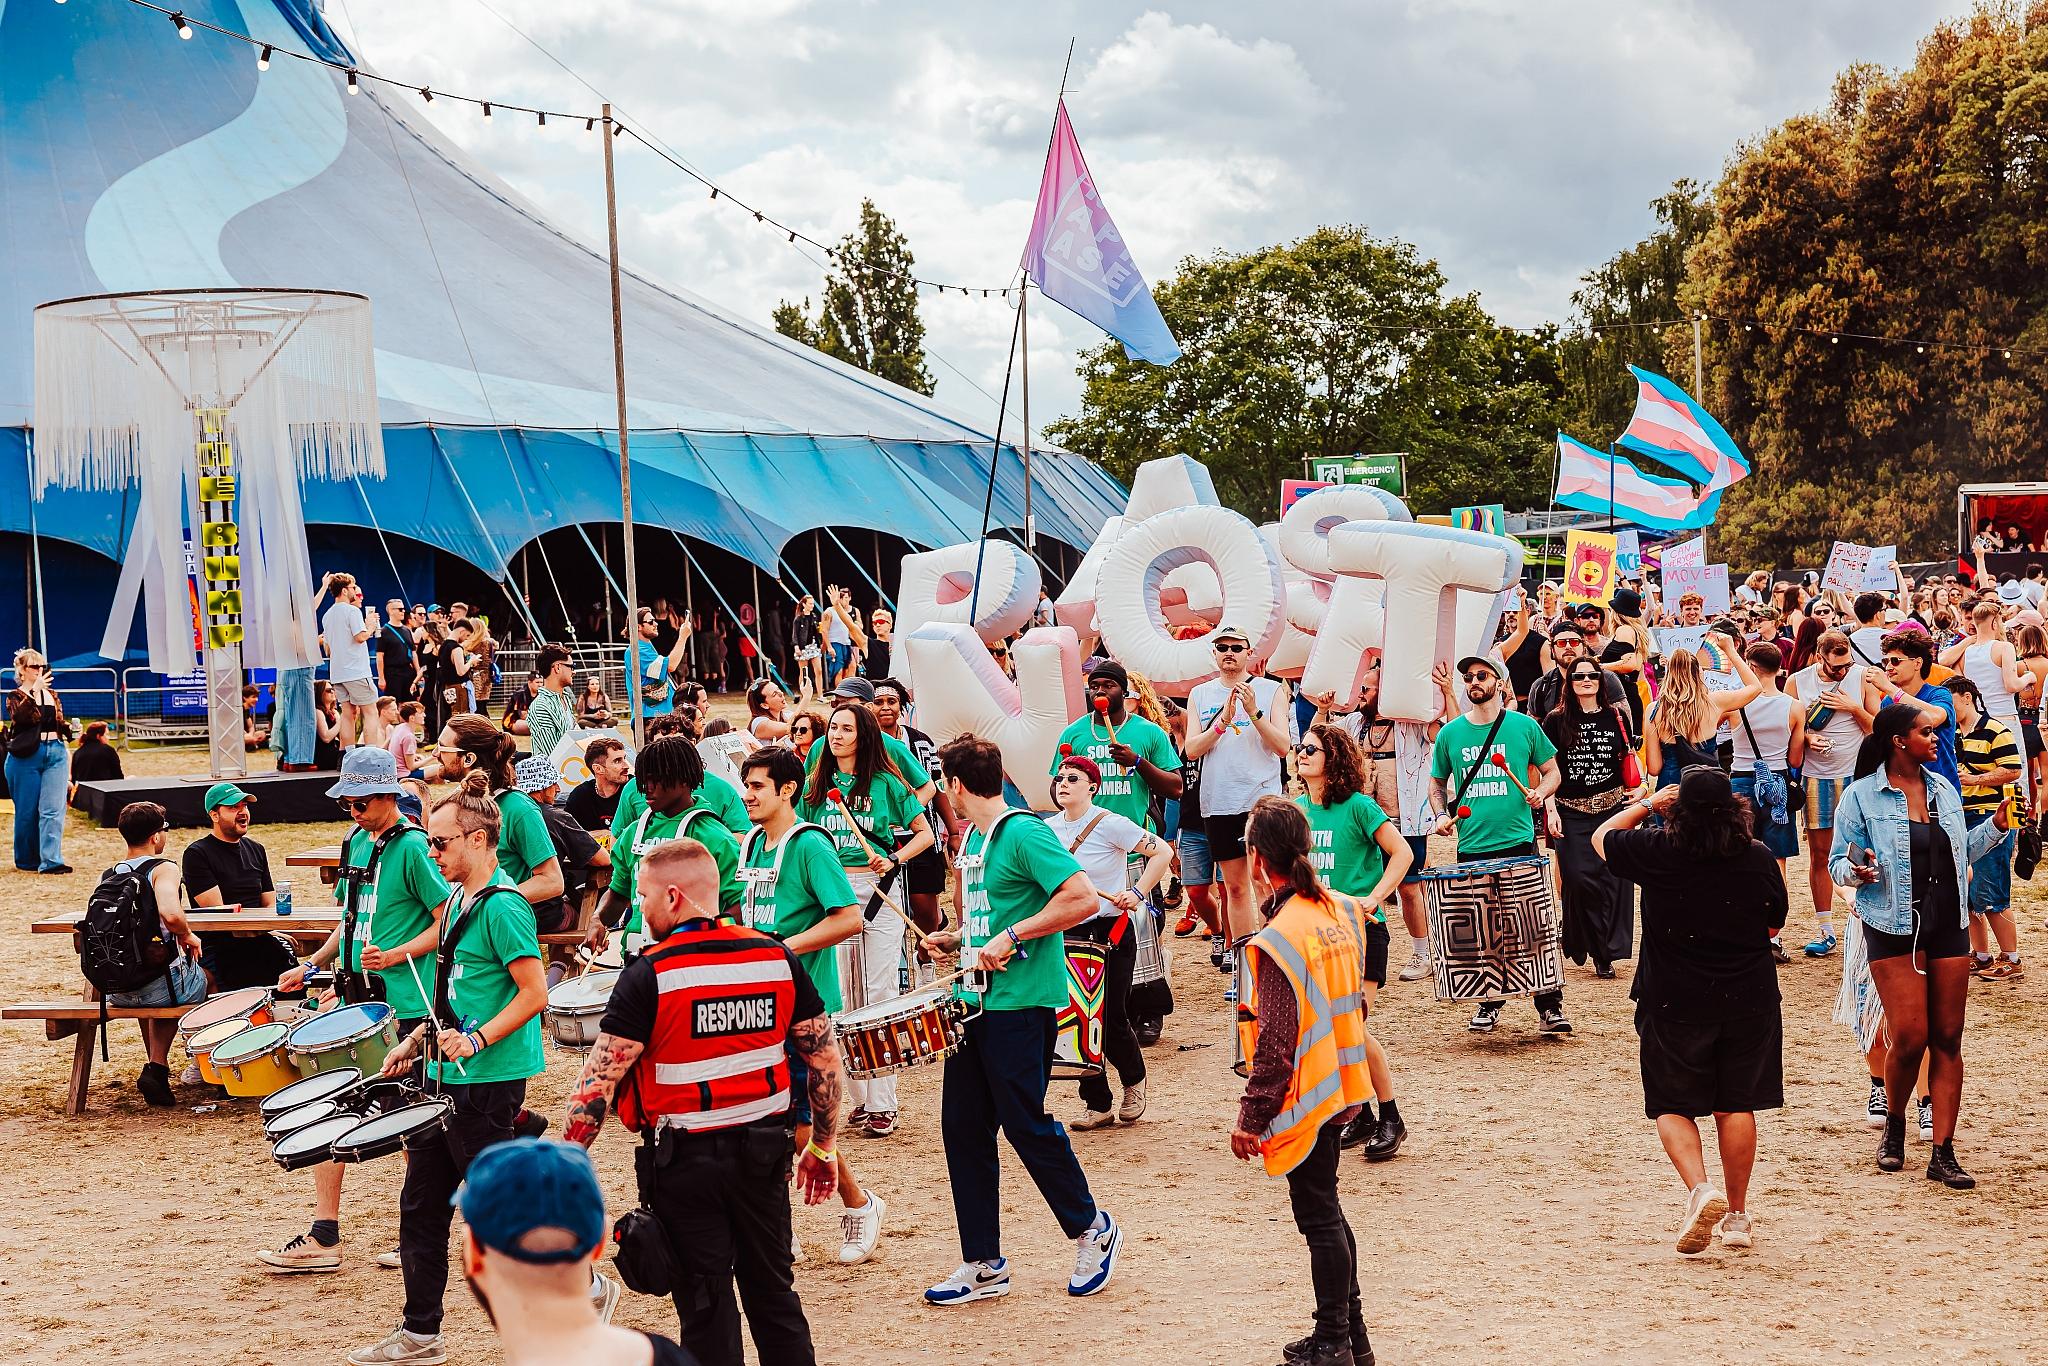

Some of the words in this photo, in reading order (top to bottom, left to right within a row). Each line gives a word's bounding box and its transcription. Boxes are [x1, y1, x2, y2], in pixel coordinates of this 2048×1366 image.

[1344, 465, 1396, 475] EMERGENCY
[1361, 478, 1380, 486] EXIT
[201, 522, 244, 650] BUMP
[1668, 635, 1680, 647] Try
[1466, 781, 1507, 798] SAMBA
[697, 998, 773, 1033] RESPONSE
